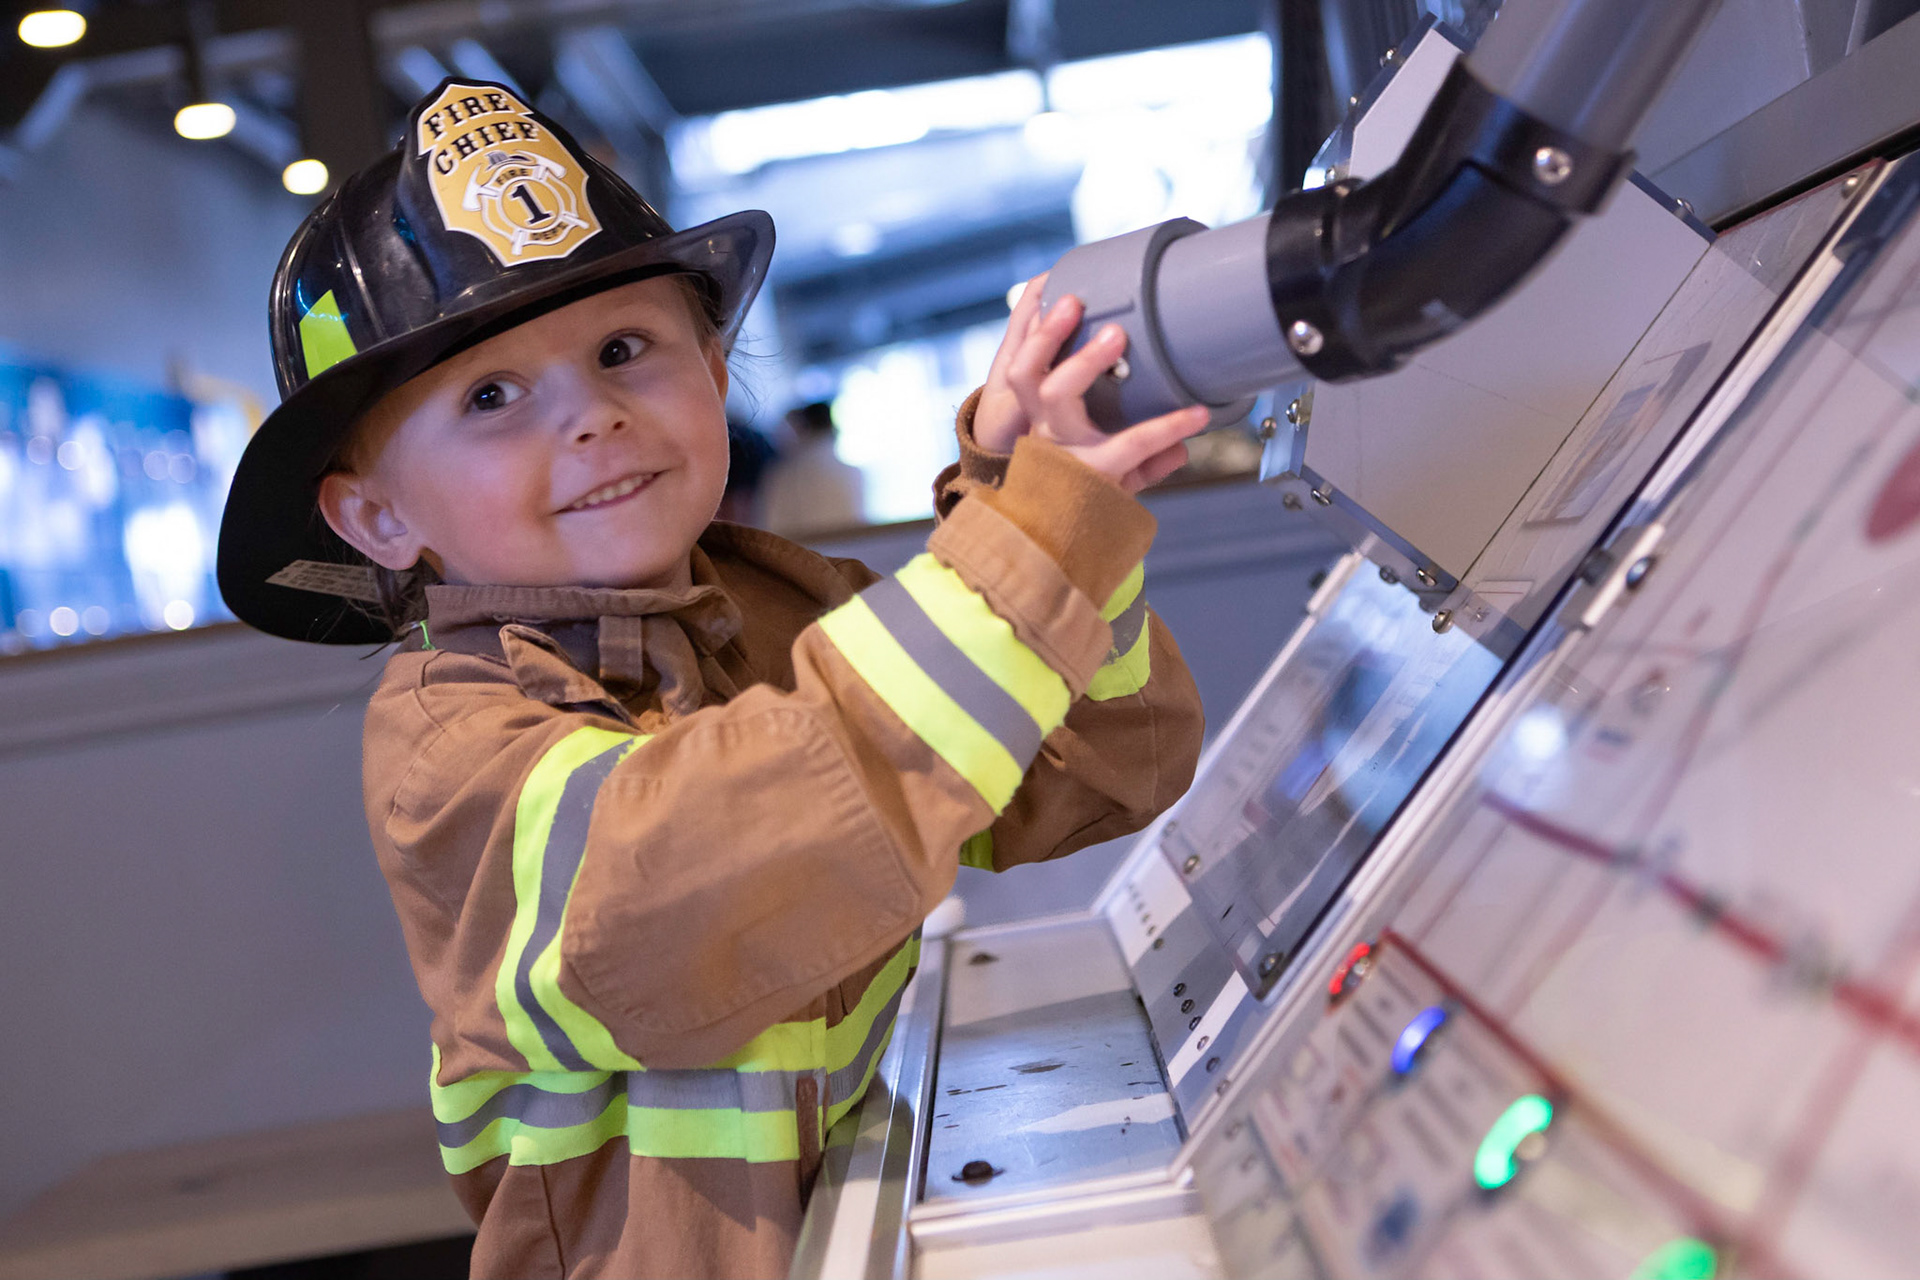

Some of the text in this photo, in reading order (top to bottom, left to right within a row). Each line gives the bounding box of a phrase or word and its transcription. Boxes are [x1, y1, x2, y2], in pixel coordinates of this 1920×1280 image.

[424, 93, 512, 141] FIRE
[435, 121, 538, 175] CHIEF
[495, 168, 529, 185] FIRE
[510, 184, 552, 224] 1
